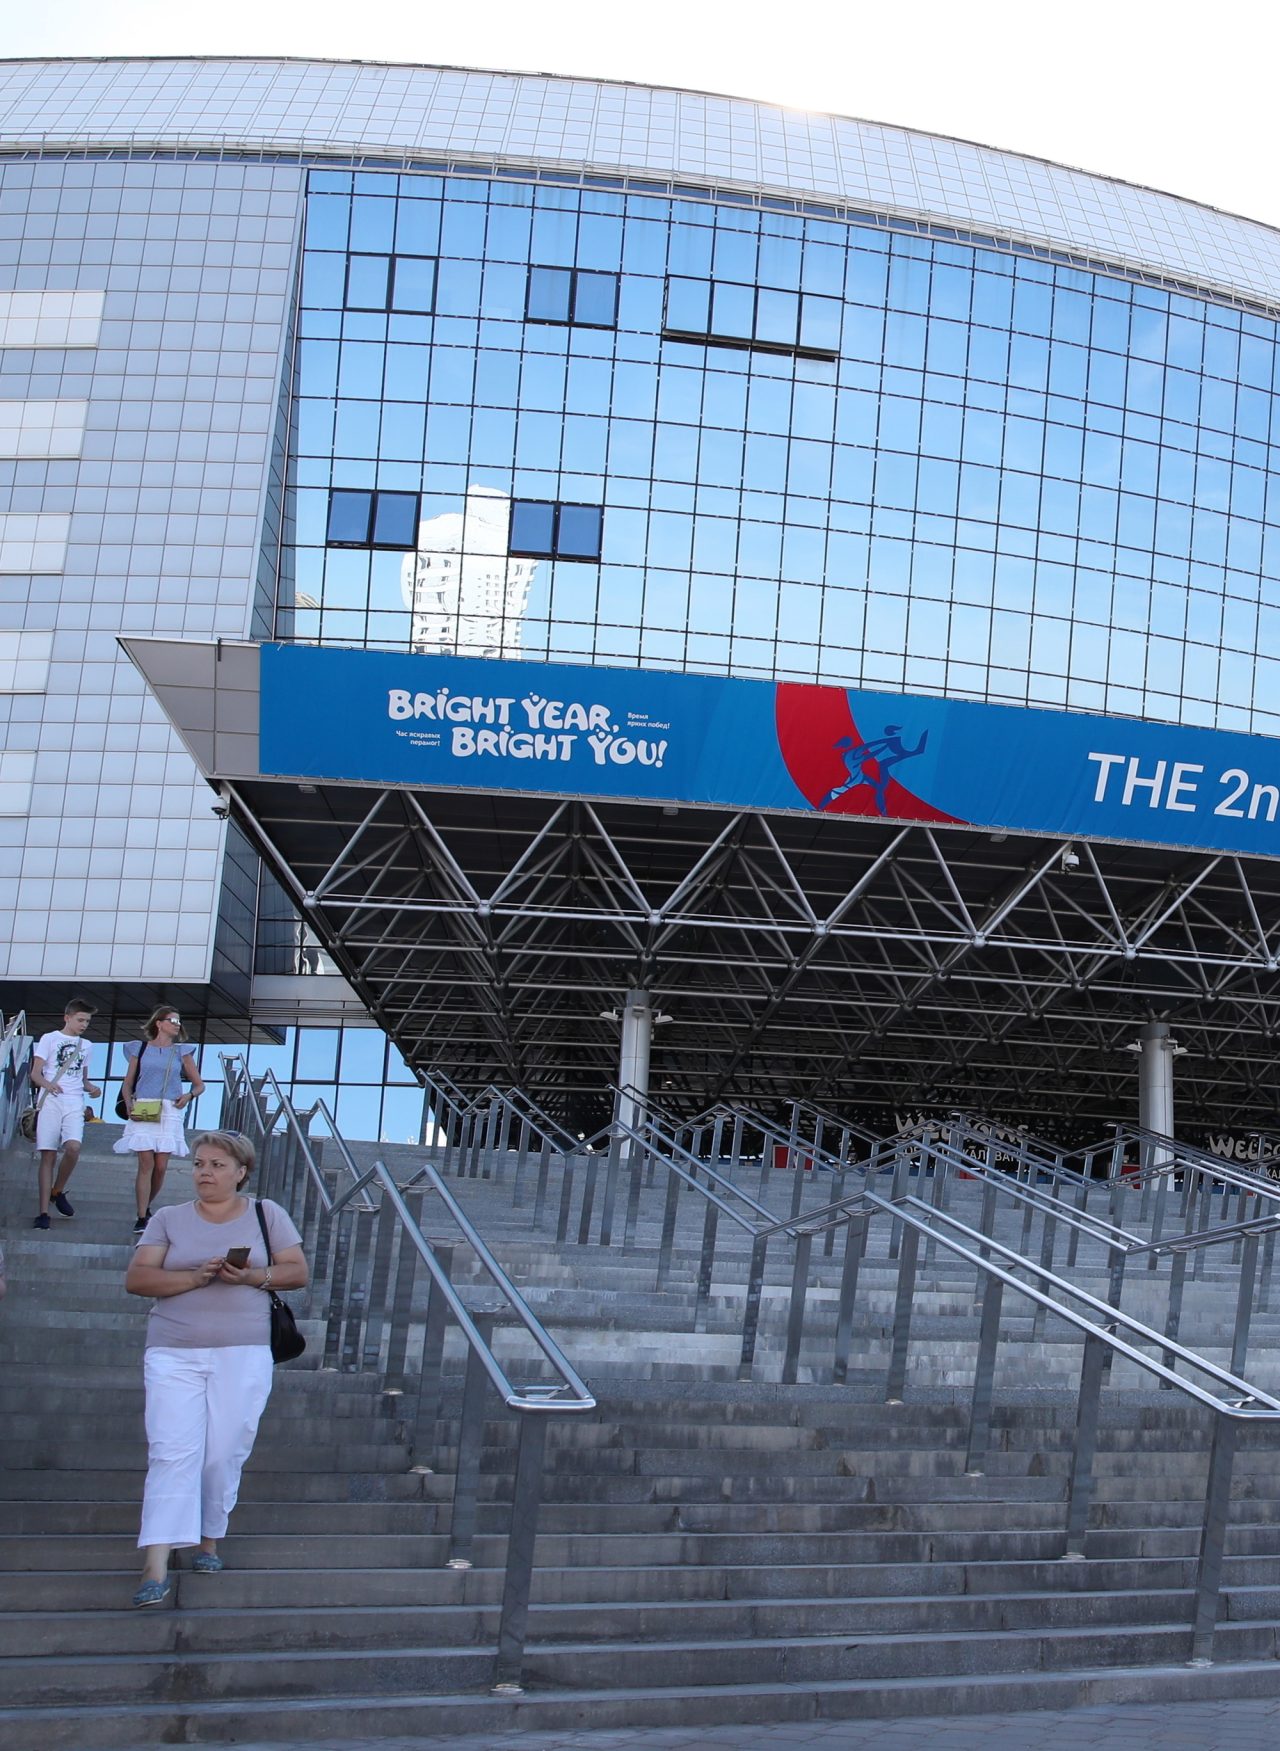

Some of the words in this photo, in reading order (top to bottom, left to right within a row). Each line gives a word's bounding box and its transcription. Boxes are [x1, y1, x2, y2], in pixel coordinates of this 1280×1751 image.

[388, 687, 516, 725] BRIGHT
[520, 691, 619, 733] YEAR,
[451, 724, 578, 762] BRIGHT
[587, 728, 668, 768] YOU!
[1087, 751, 1204, 813] THE
